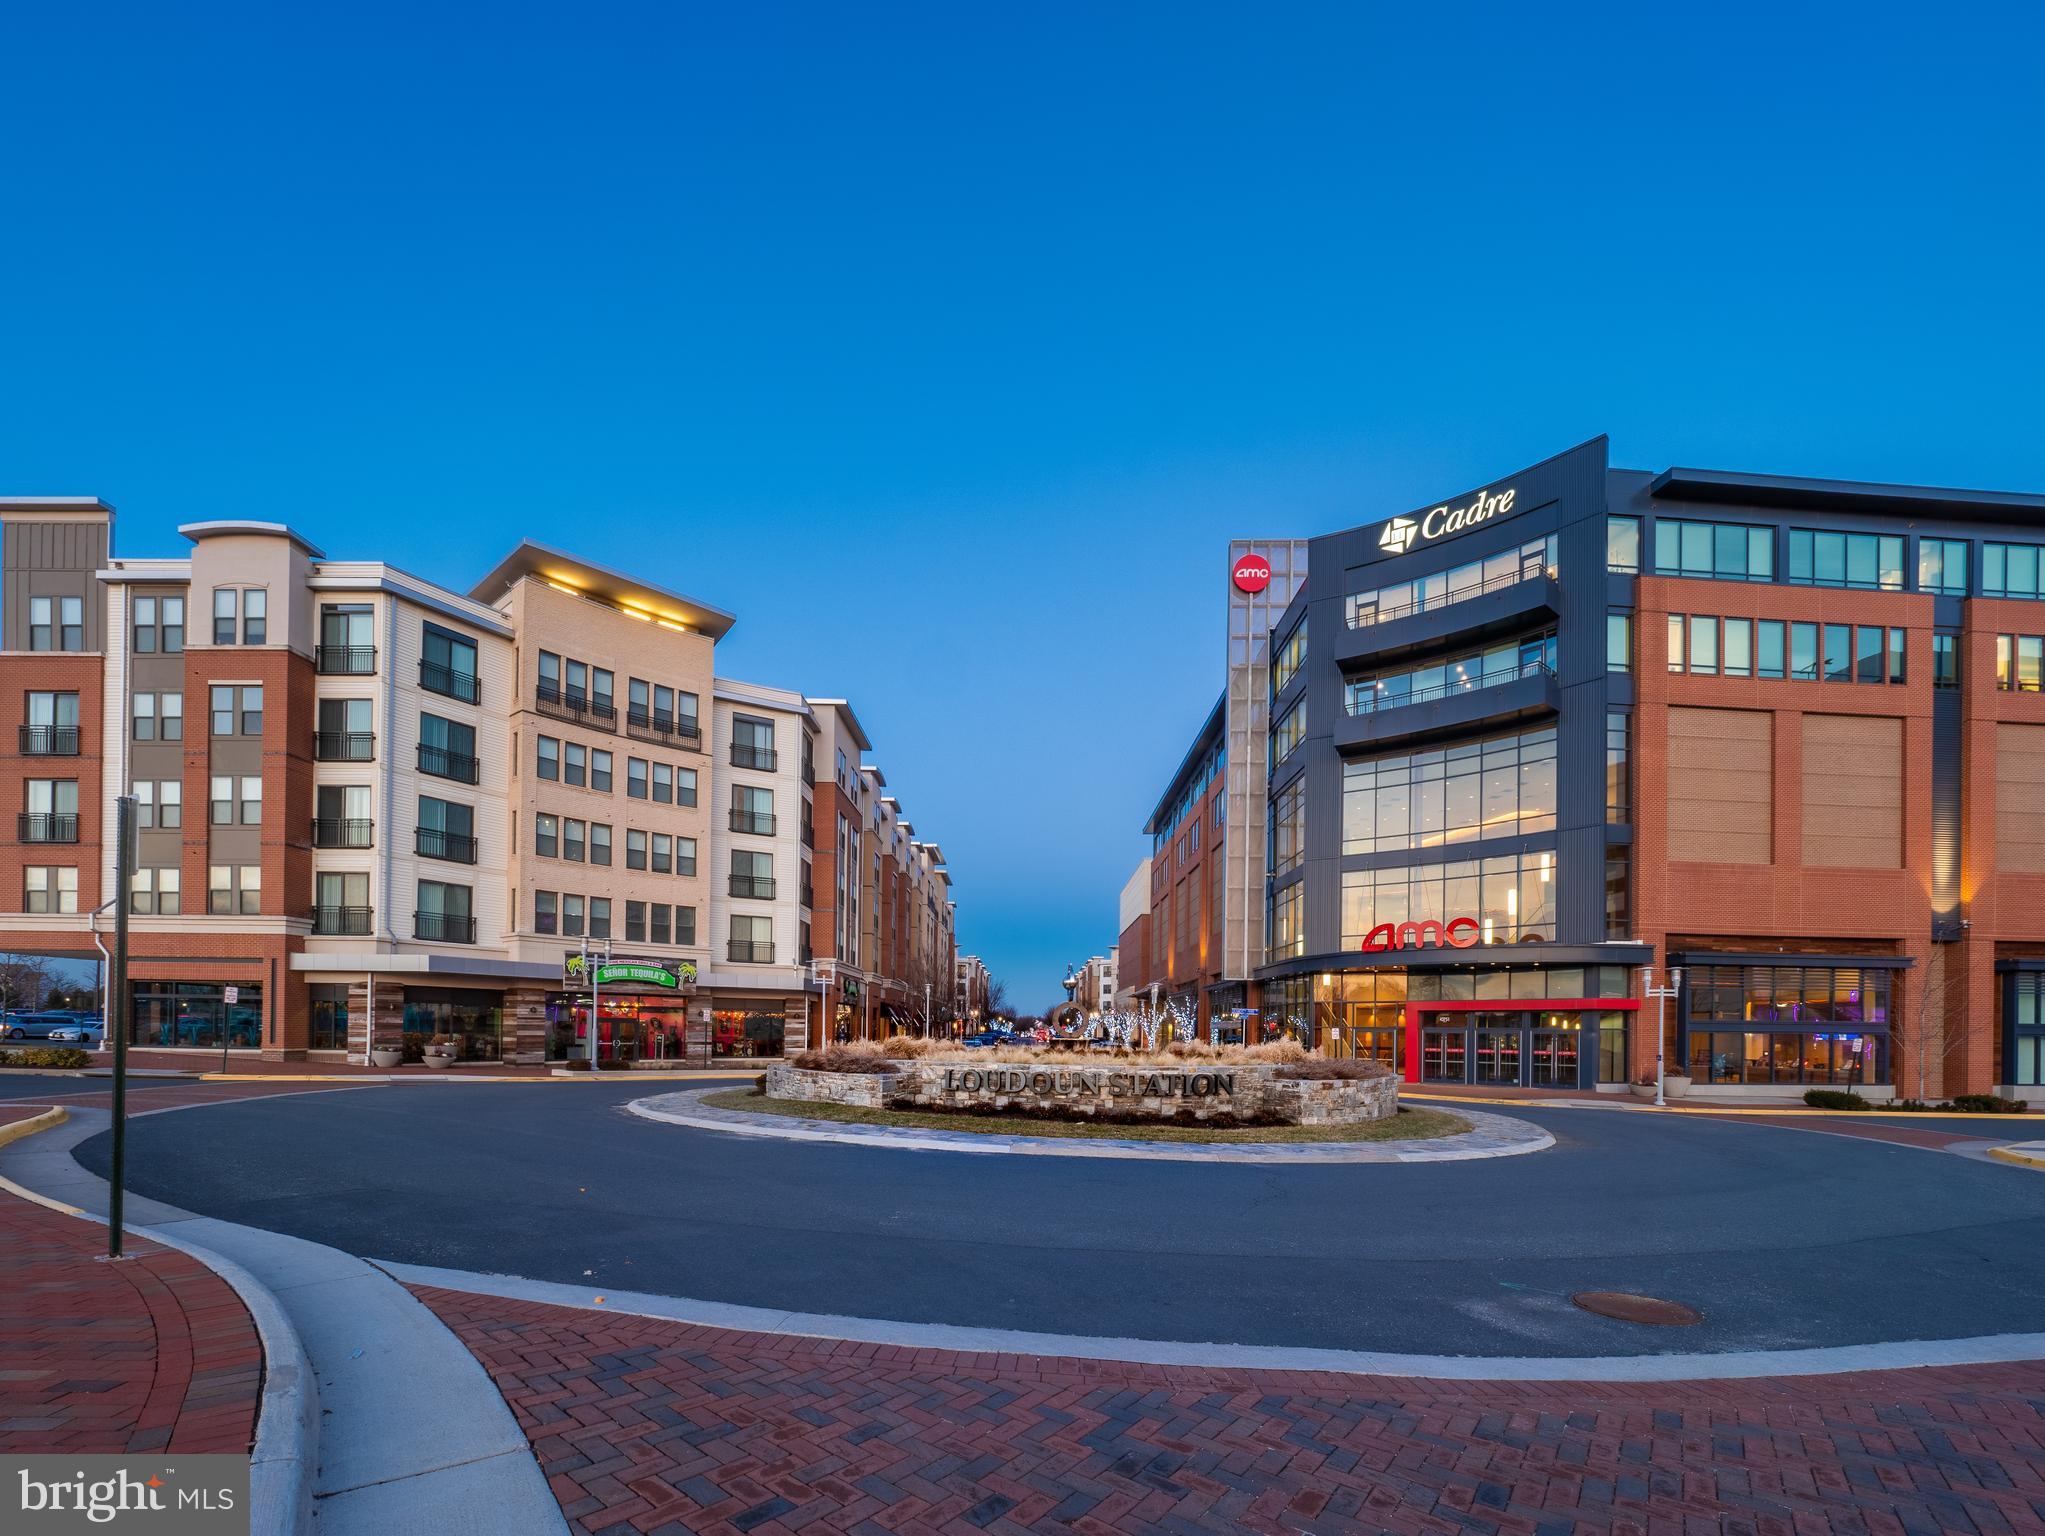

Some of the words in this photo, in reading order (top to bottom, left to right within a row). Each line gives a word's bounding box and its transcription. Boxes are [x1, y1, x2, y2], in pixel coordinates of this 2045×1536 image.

[1422, 489, 1515, 539] Cadre
[603, 967, 628, 978] SEÑOR
[630, 969, 666, 981] TEQUILA'S
[943, 1069, 1100, 1095] LOUDOUN
[1108, 1070, 1235, 1097] STATION
